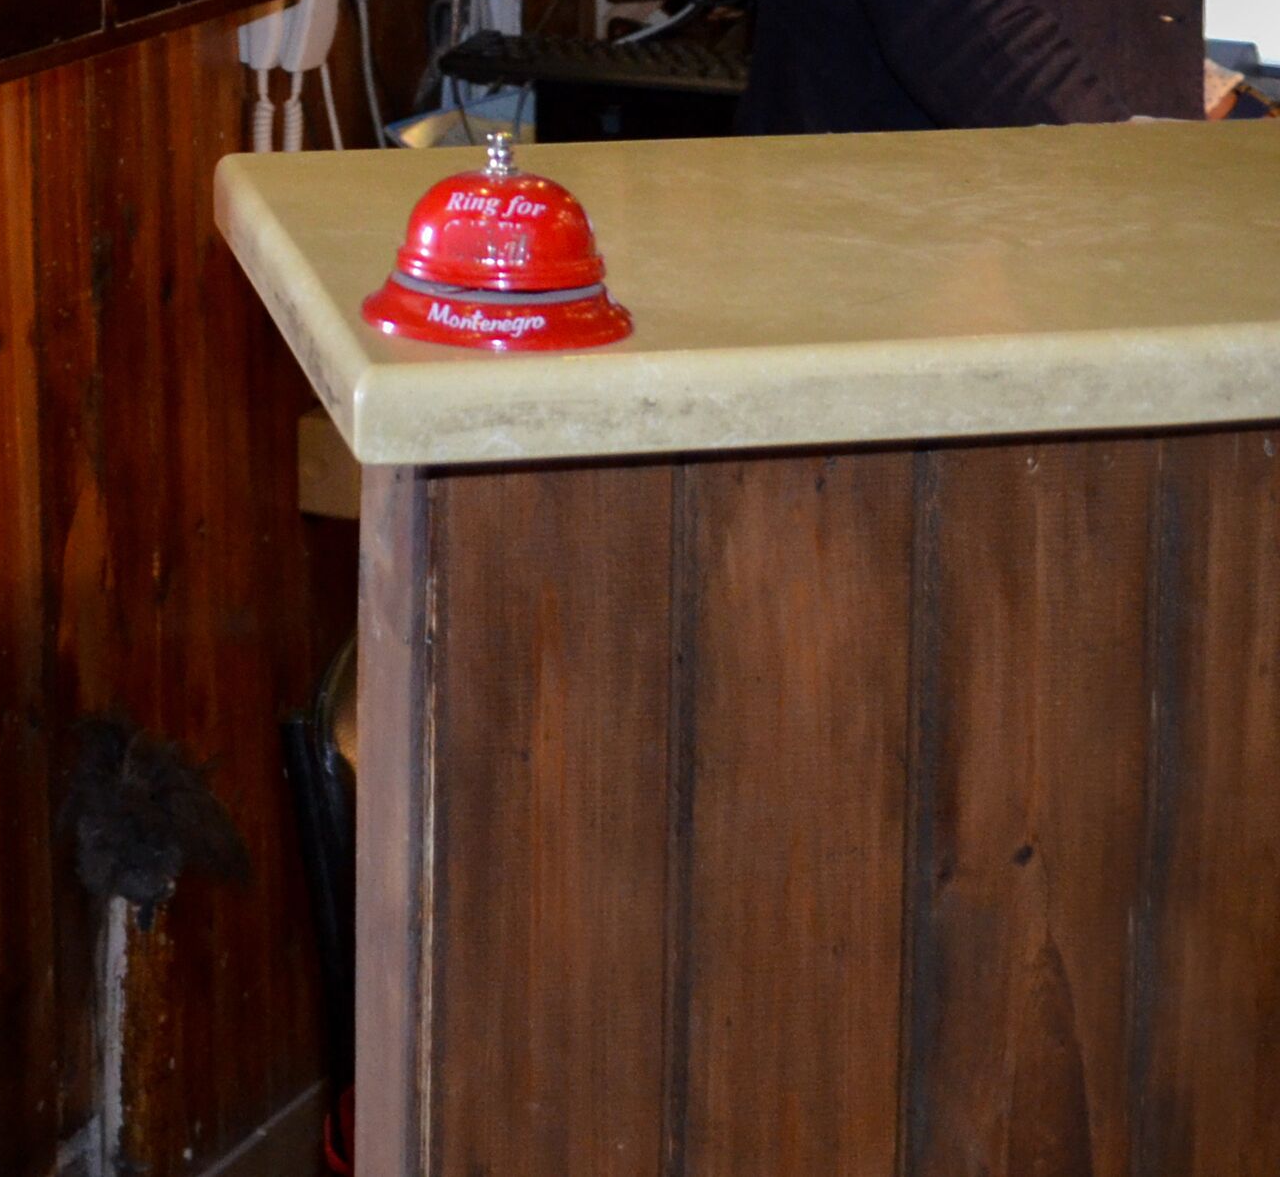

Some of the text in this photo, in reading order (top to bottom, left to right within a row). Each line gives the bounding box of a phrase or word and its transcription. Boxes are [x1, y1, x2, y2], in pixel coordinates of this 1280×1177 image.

[445, 191, 546, 219] Ring for
[427, 302, 546, 338] Montenegro
